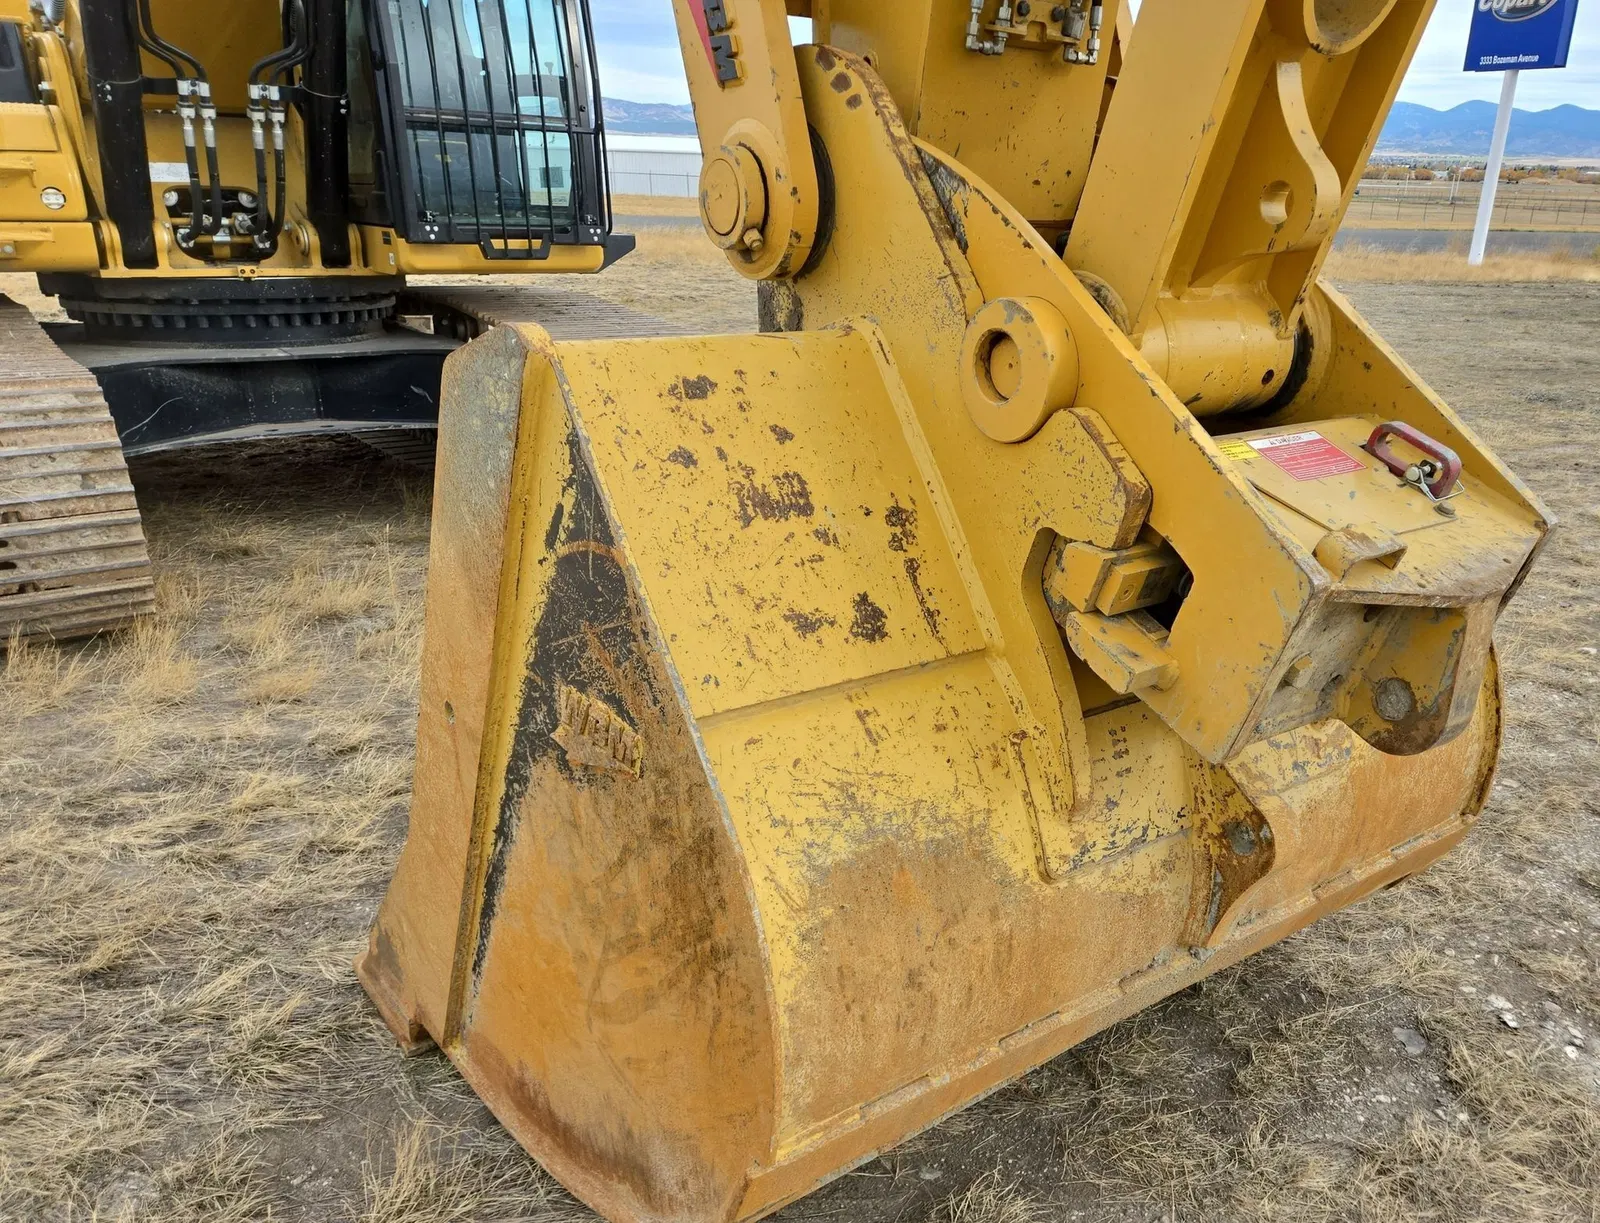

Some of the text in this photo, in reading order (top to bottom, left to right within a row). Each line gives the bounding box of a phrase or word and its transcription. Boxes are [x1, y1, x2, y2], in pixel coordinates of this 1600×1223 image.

[1478, 0, 1546, 12] Copa
[1480, 54, 1539, 65] 3333 Bozeman Avenue
